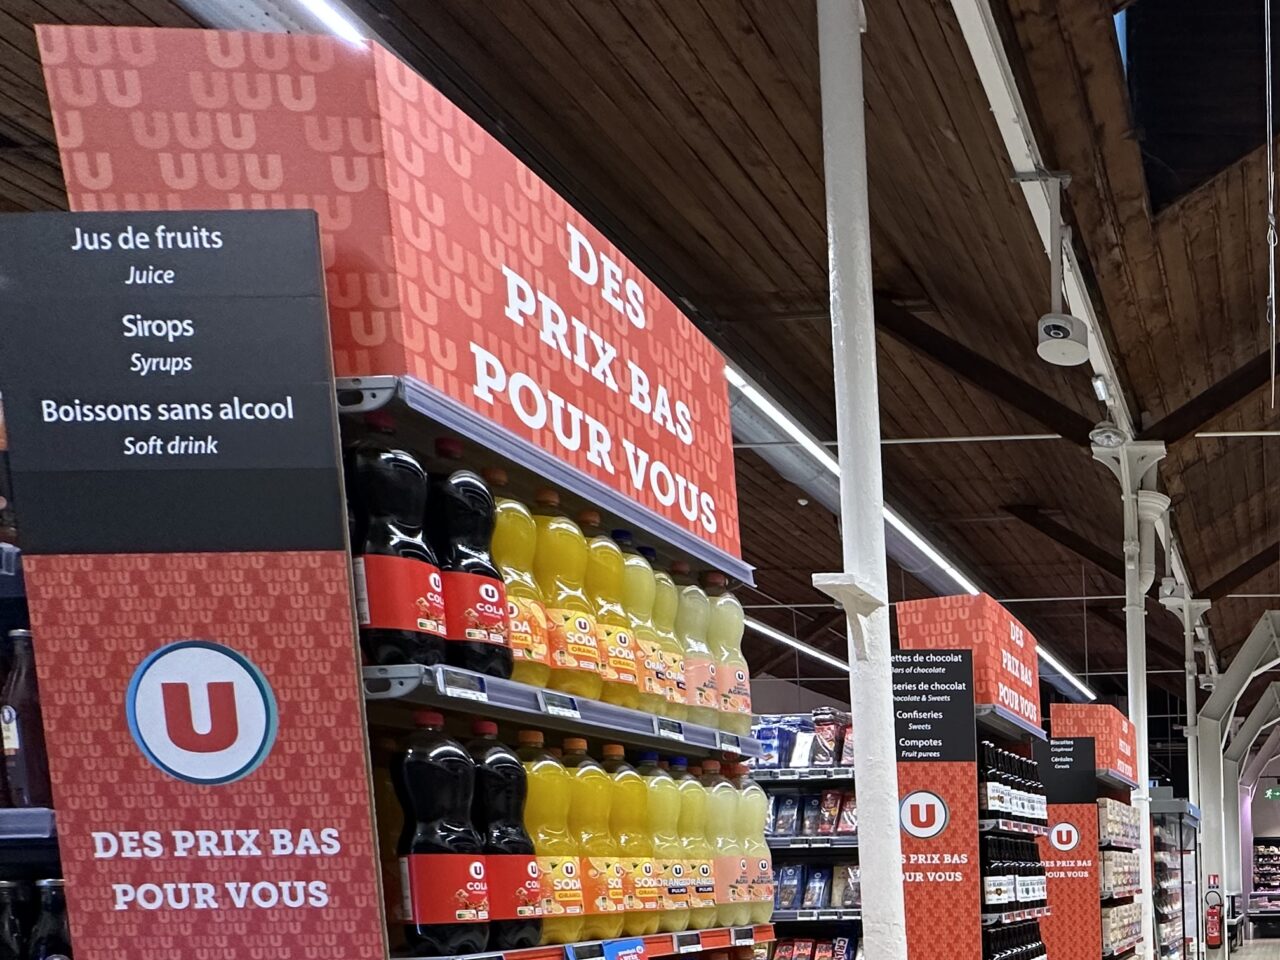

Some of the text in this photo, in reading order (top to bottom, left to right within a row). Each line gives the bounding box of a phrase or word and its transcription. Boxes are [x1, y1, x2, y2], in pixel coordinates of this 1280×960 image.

[71, 225, 223, 251] Jus de fruits
[125, 266, 175, 285] Juice
[566, 222, 646, 329] DES
[122, 314, 194, 342] Sirops
[130, 353, 193, 376] Syrups
[502, 264, 693, 445] PRIX BAS
[41, 397, 294, 422] Boissons sans alcool
[123, 435, 218, 456] Soft drink
[469, 341, 717, 534] POUR VOUS
[913, 653, 925, 662] de
[926, 653, 962, 662] chocolat
[918, 681, 929, 690] de
[930, 681, 967, 690] chocolat
[161, 682, 239, 753] U
[896, 710, 943, 719] Confiseries
[899, 738, 942, 748] Compotes
[91, 828, 341, 858] DES PRIX BAS
[909, 853, 940, 864] PRIX
[943, 853, 968, 864] BAS
[926, 872, 963, 882] VOUS
[112, 881, 329, 910] POUR VOUS
